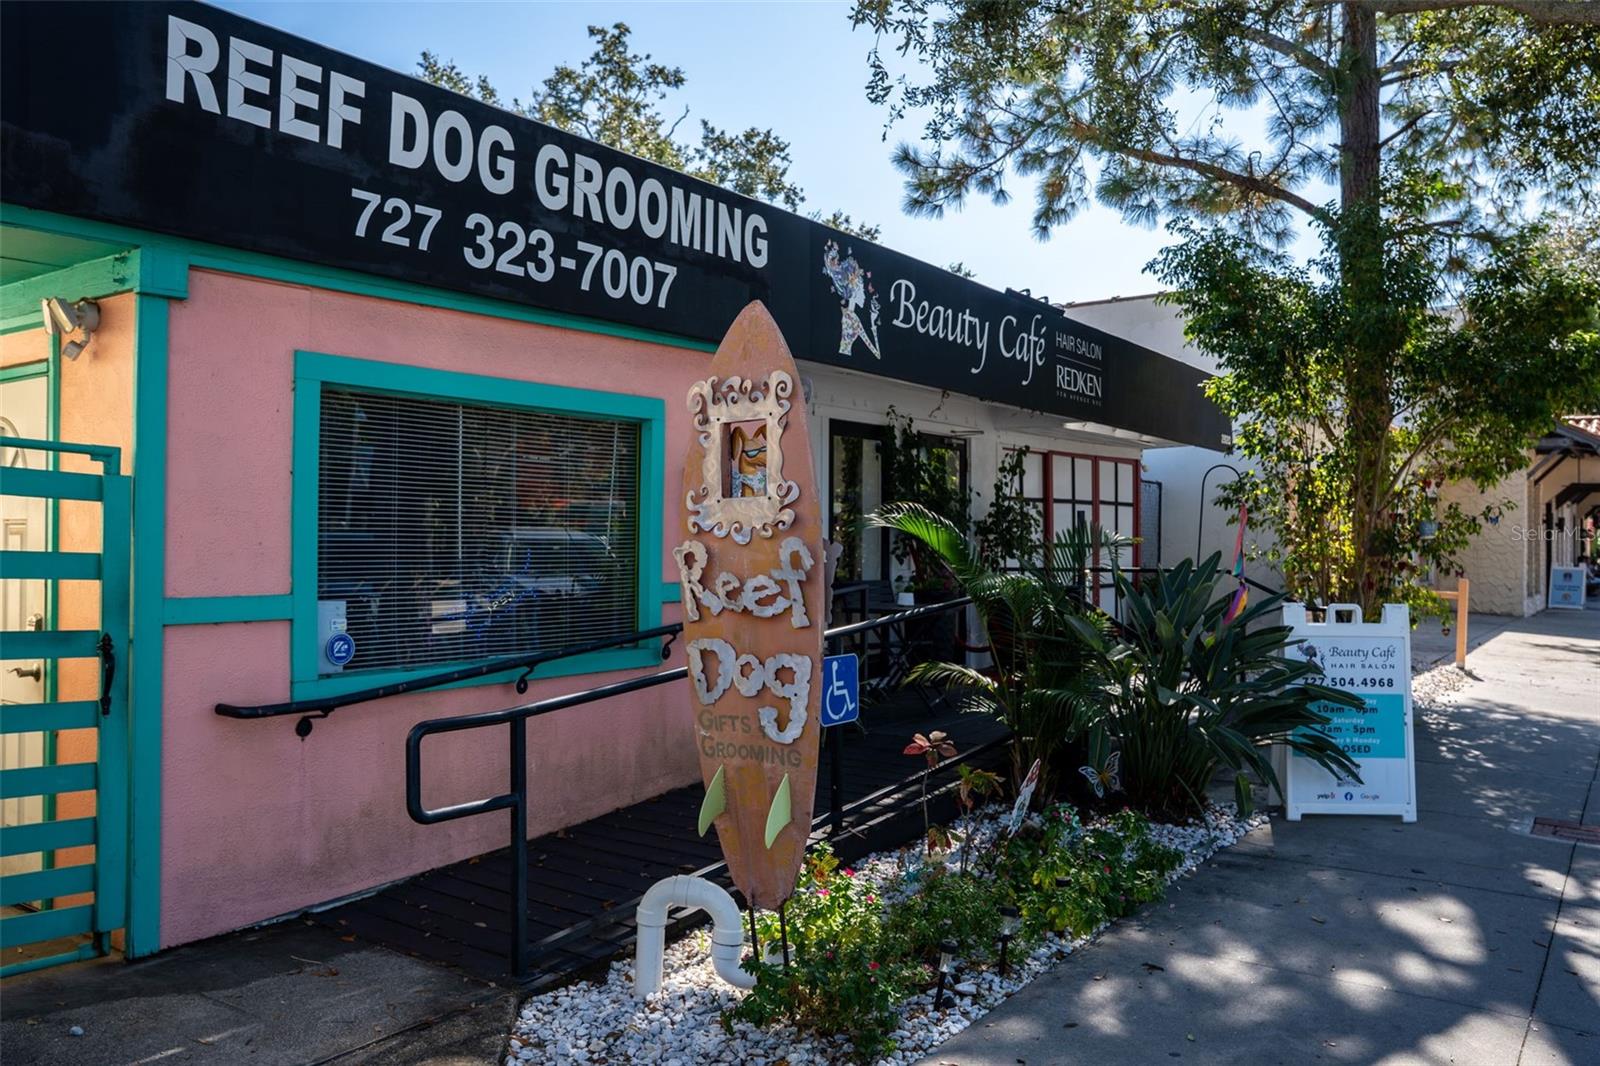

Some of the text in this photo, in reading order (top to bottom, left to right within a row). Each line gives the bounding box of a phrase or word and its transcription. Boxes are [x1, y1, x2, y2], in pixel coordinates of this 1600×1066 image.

[165, 15, 769, 269] REEF DOG GROOMING
[351, 189, 678, 309] 727 323-7007
[890, 279, 1046, 386] Beauty Café
[1055, 331, 1102, 361] HAIR SALON
[1056, 364, 1102, 398] REDKEN
[673, 536, 815, 629] Reef
[1328, 644, 1396, 663] Beauty Café
[687, 638, 812, 744] Dog
[1302, 677, 1395, 688] 727.504.4968
[1317, 704, 1345, 713] 10am
[1332, 716, 1365, 725] Saturday
[1320, 725, 1342, 734] 9am
[1353, 725, 1376, 735] 5pm
[1342, 745, 1371, 753] OSED
